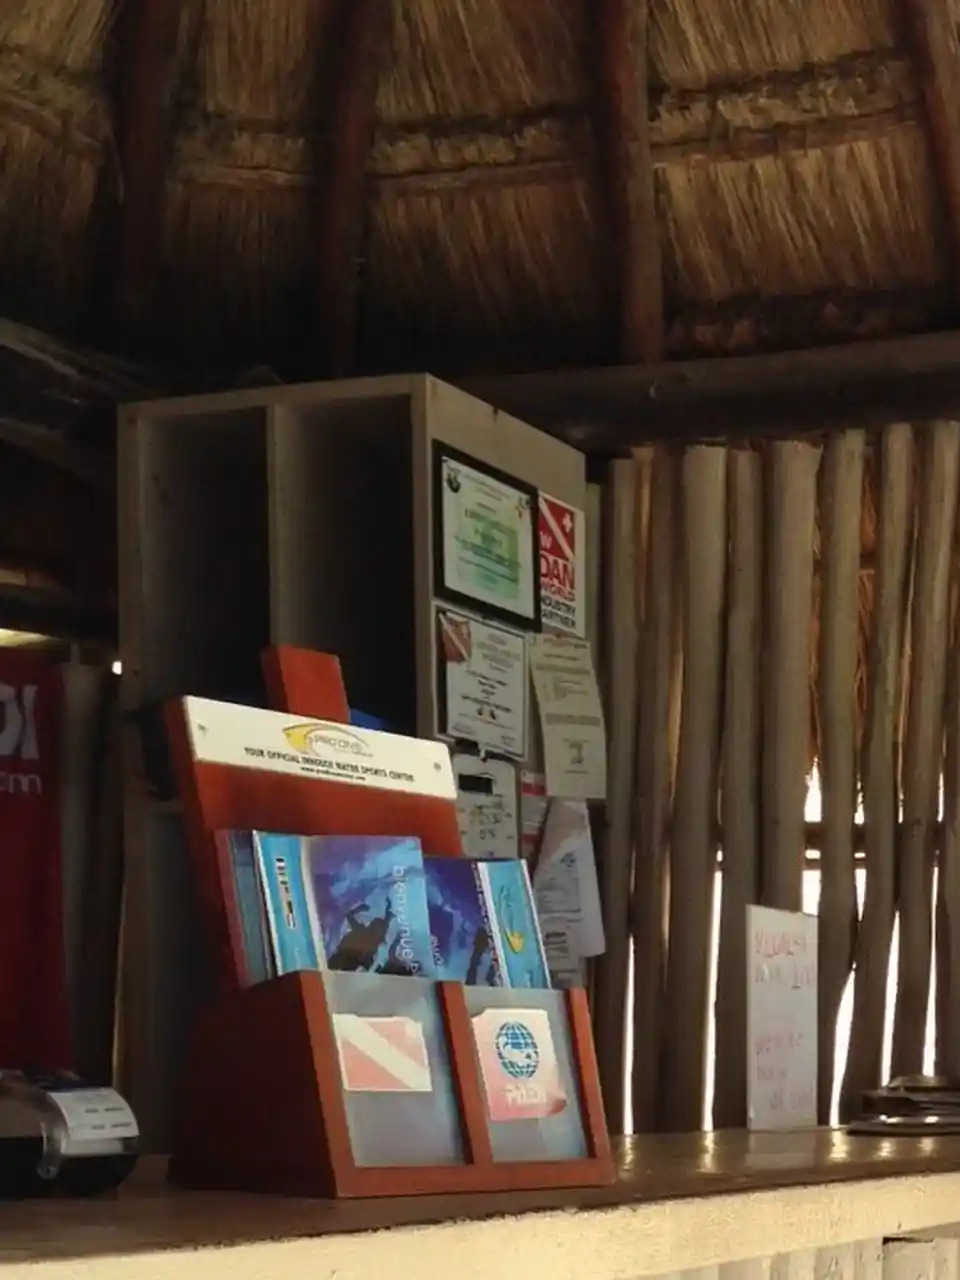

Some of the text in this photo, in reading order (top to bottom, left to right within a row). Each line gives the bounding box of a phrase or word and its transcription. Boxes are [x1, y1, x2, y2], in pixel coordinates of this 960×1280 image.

[244, 747, 265, 757] YOUR
[267, 750, 300, 763] OFFICIAL
[335, 762, 360, 773] WATER
[361, 766, 387, 778] SPORTS
[389, 770, 414, 782] CENTER
[392, 865, 414, 959] bienvenue
